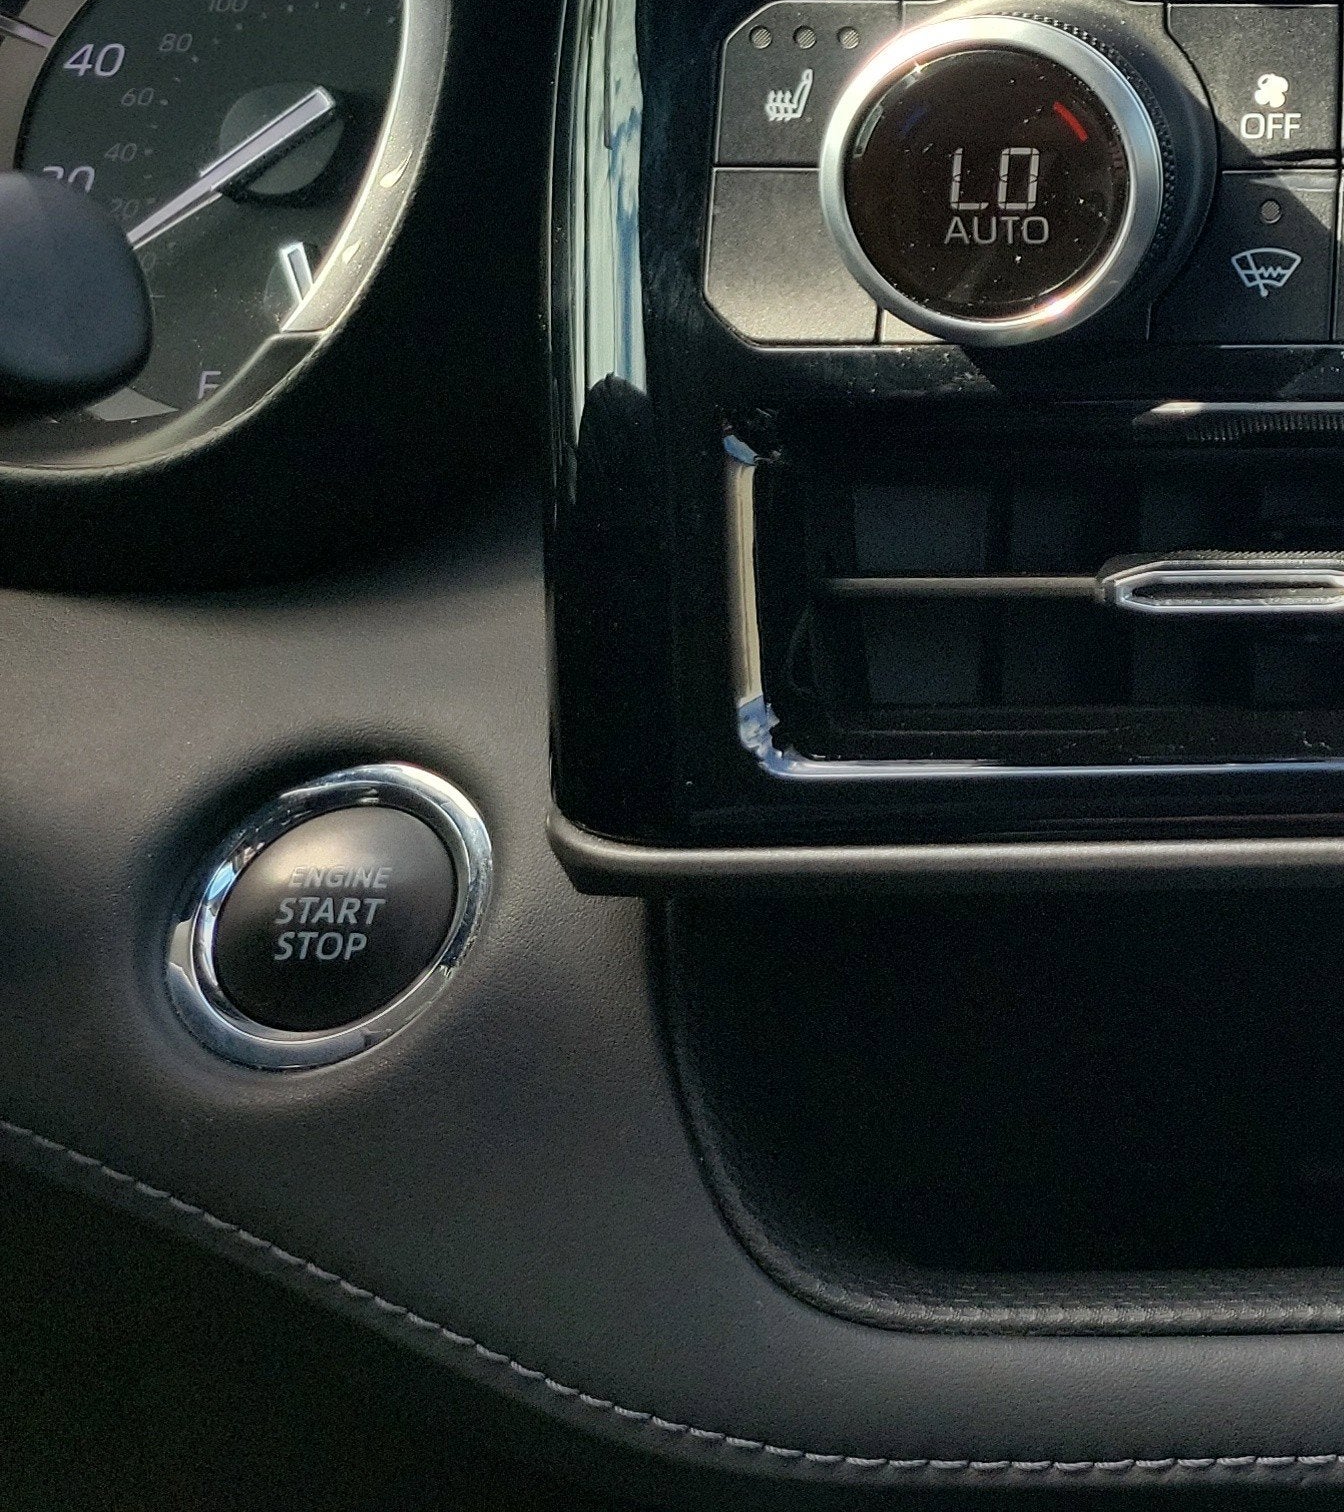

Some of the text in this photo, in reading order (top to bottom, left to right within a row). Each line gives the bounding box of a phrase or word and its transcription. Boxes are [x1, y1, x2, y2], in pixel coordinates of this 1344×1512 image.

[159, 34, 192, 53] 80
[62, 43, 126, 78] 40
[121, 88, 154, 107] 60
[1240, 113, 1301, 140] OFF
[104, 143, 138, 162] 40
[949, 146, 1040, 211] LO
[944, 215, 1050, 245] AUTO
[288, 864, 393, 890] ENGINE
[274, 896, 387, 925] START
[273, 932, 368, 961] STOP
